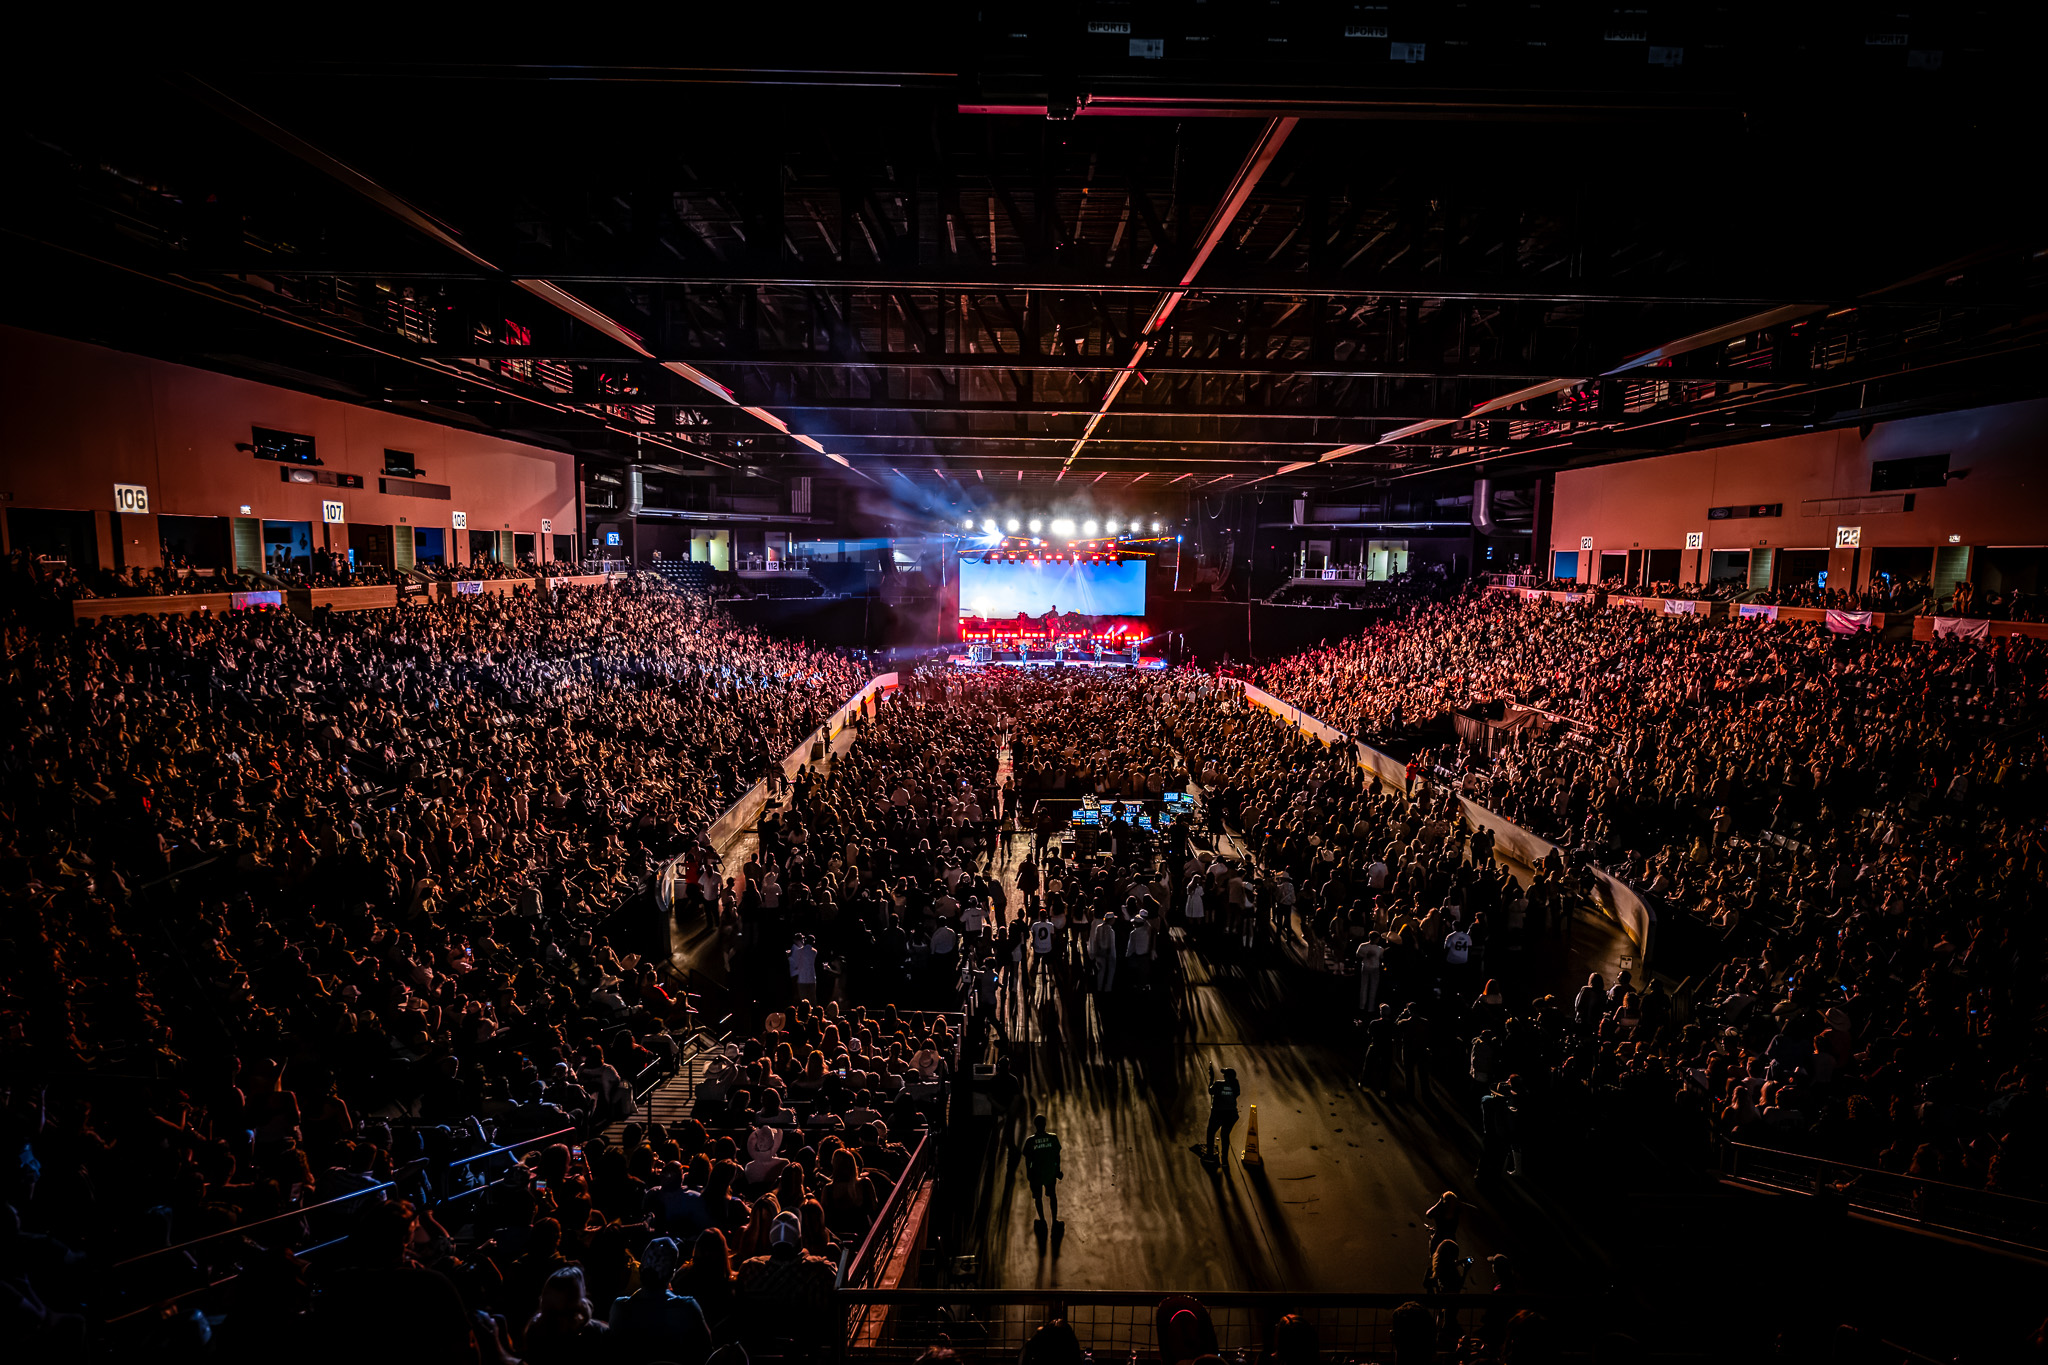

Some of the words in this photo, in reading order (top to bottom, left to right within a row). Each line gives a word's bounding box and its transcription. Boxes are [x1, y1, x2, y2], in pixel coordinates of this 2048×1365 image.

[1090, 23, 1128, 32] SPORTS
[1347, 27, 1386, 36] SPORTS
[117, 488, 146, 510] 106
[326, 504, 342, 520] 107
[454, 514, 466, 527] 108
[1581, 538, 1592, 549] 120
[1688, 535, 1700, 547] 121
[768, 562, 778, 570] 112
[1323, 571, 1334, 579] 117
[1454, 940, 1468, 951] 64
